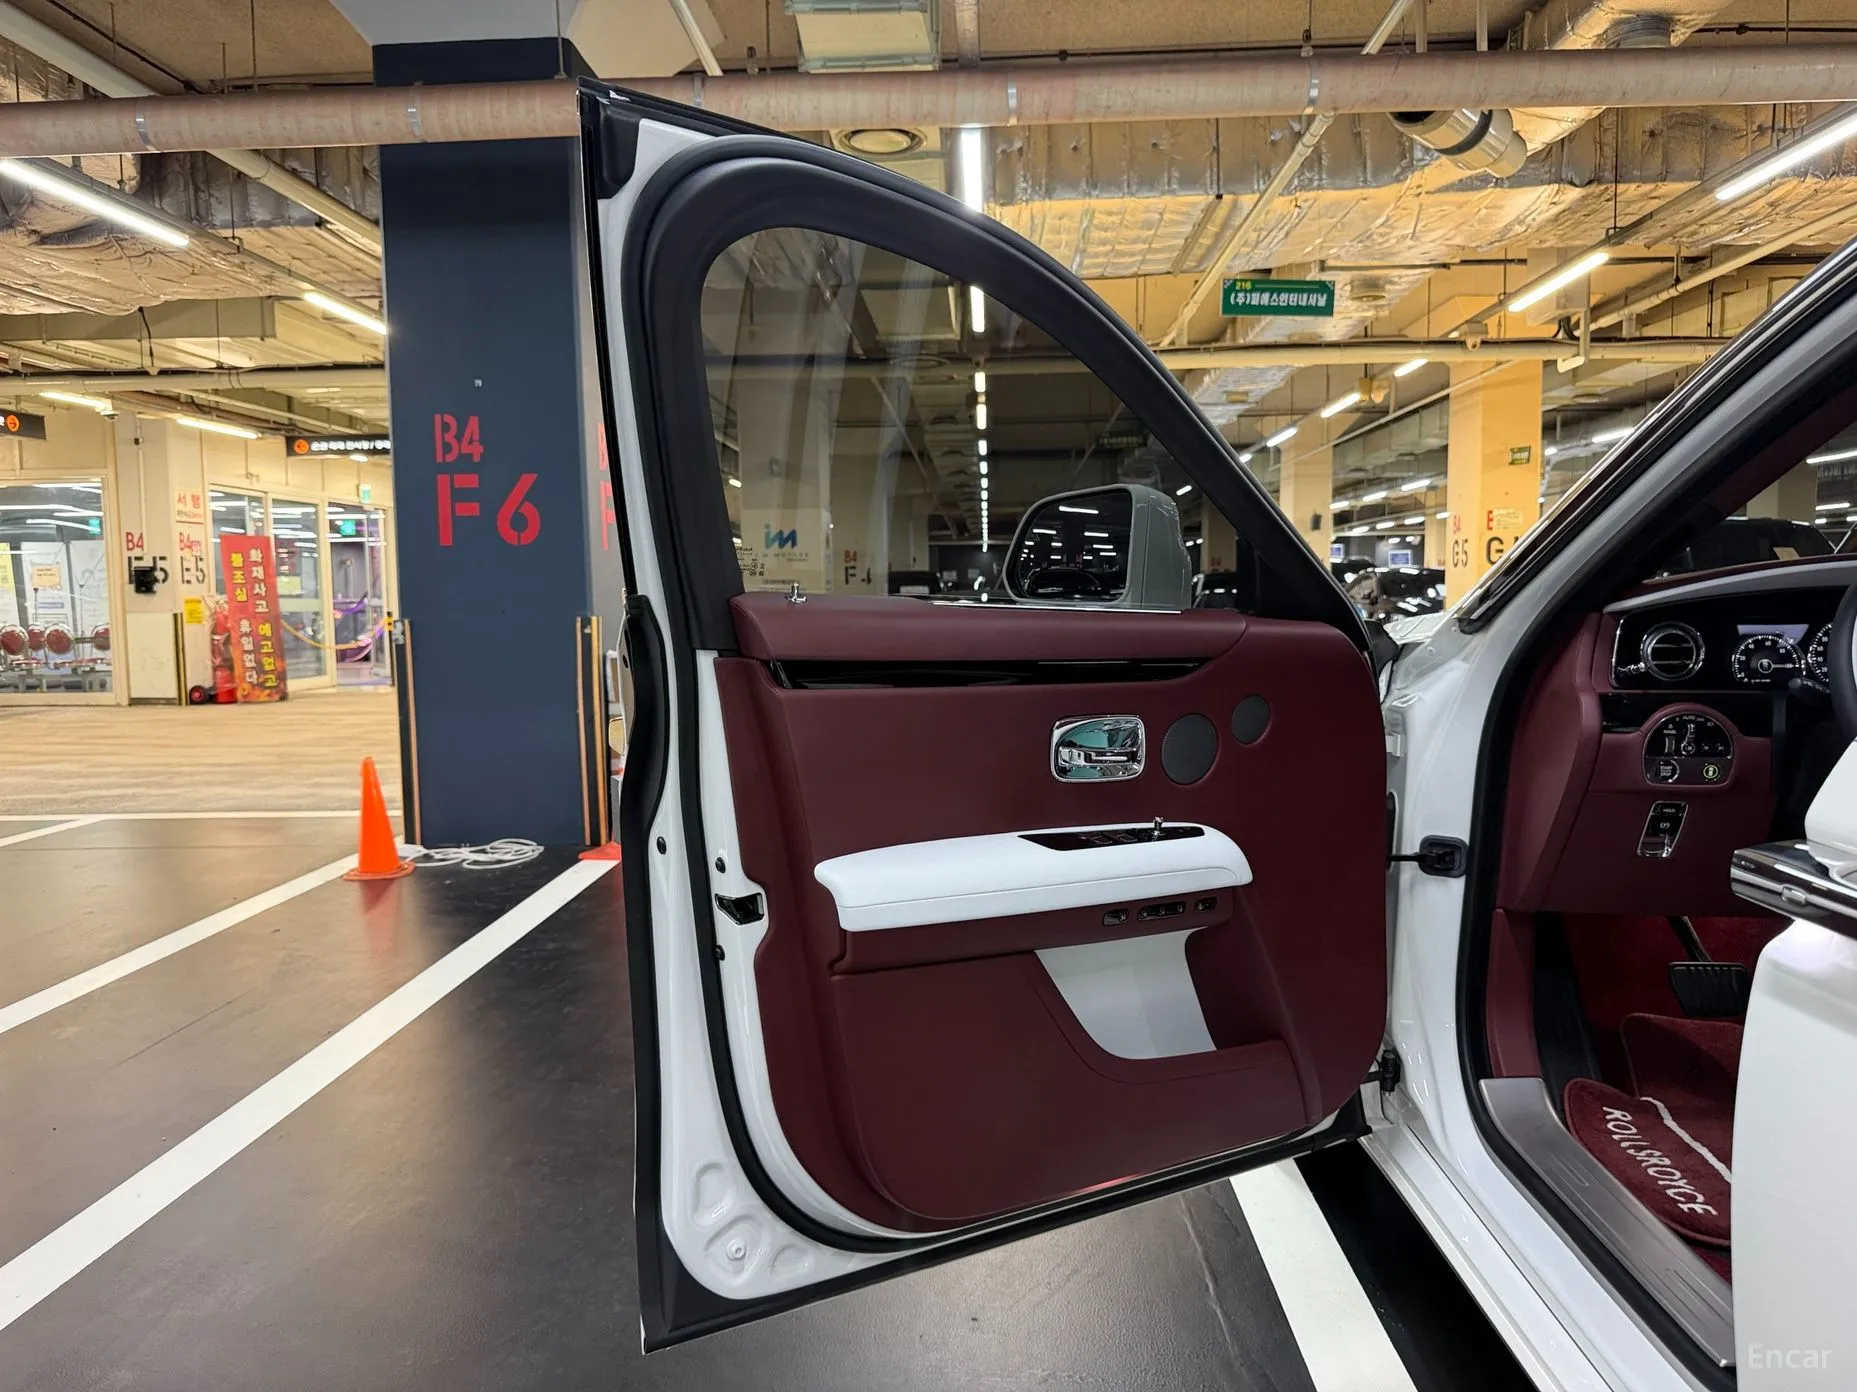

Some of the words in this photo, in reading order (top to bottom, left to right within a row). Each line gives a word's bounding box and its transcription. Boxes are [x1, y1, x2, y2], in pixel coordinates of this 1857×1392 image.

[433, 413, 484, 463] B4
[125, 532, 144, 551] B4
[1452, 536, 1469, 568] G5
[248, 548, 270, 613] 화재사고
[229, 552, 248, 602] 불조심
[239, 618, 258, 685] 휴일없다
[257, 622, 279, 688] 예고없고
